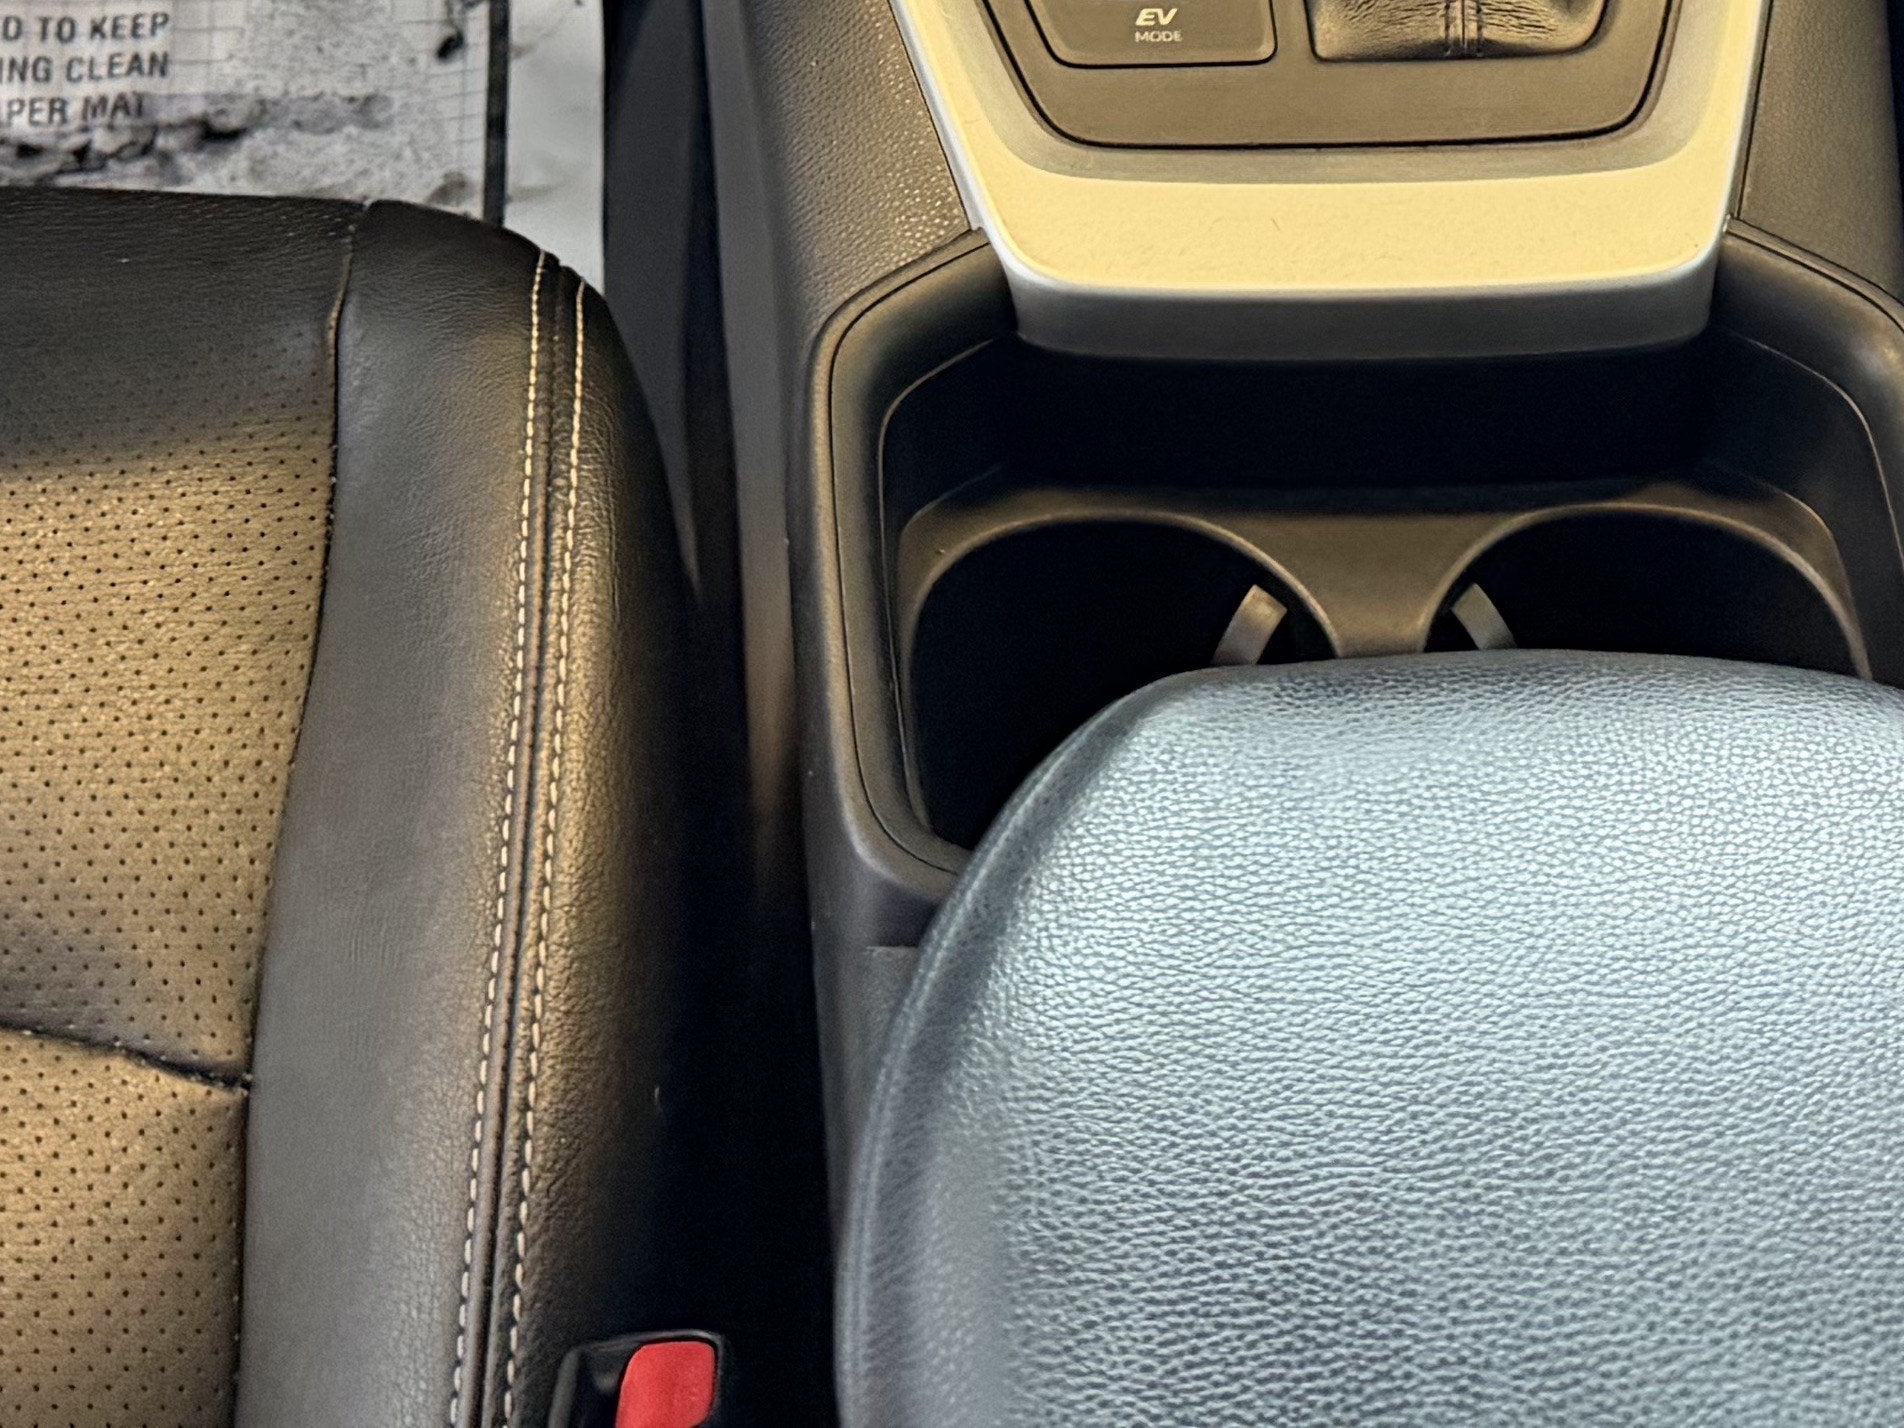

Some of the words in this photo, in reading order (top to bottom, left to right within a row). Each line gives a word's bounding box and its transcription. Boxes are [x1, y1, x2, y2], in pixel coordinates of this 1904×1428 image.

[37, 14, 76, 45] TO
[89, 11, 170, 41] KEEP
[1135, 7, 1178, 26] EV
[1134, 30, 1183, 42] MODE
[64, 51, 170, 84] CLEAN
[80, 92, 147, 123] MAT
